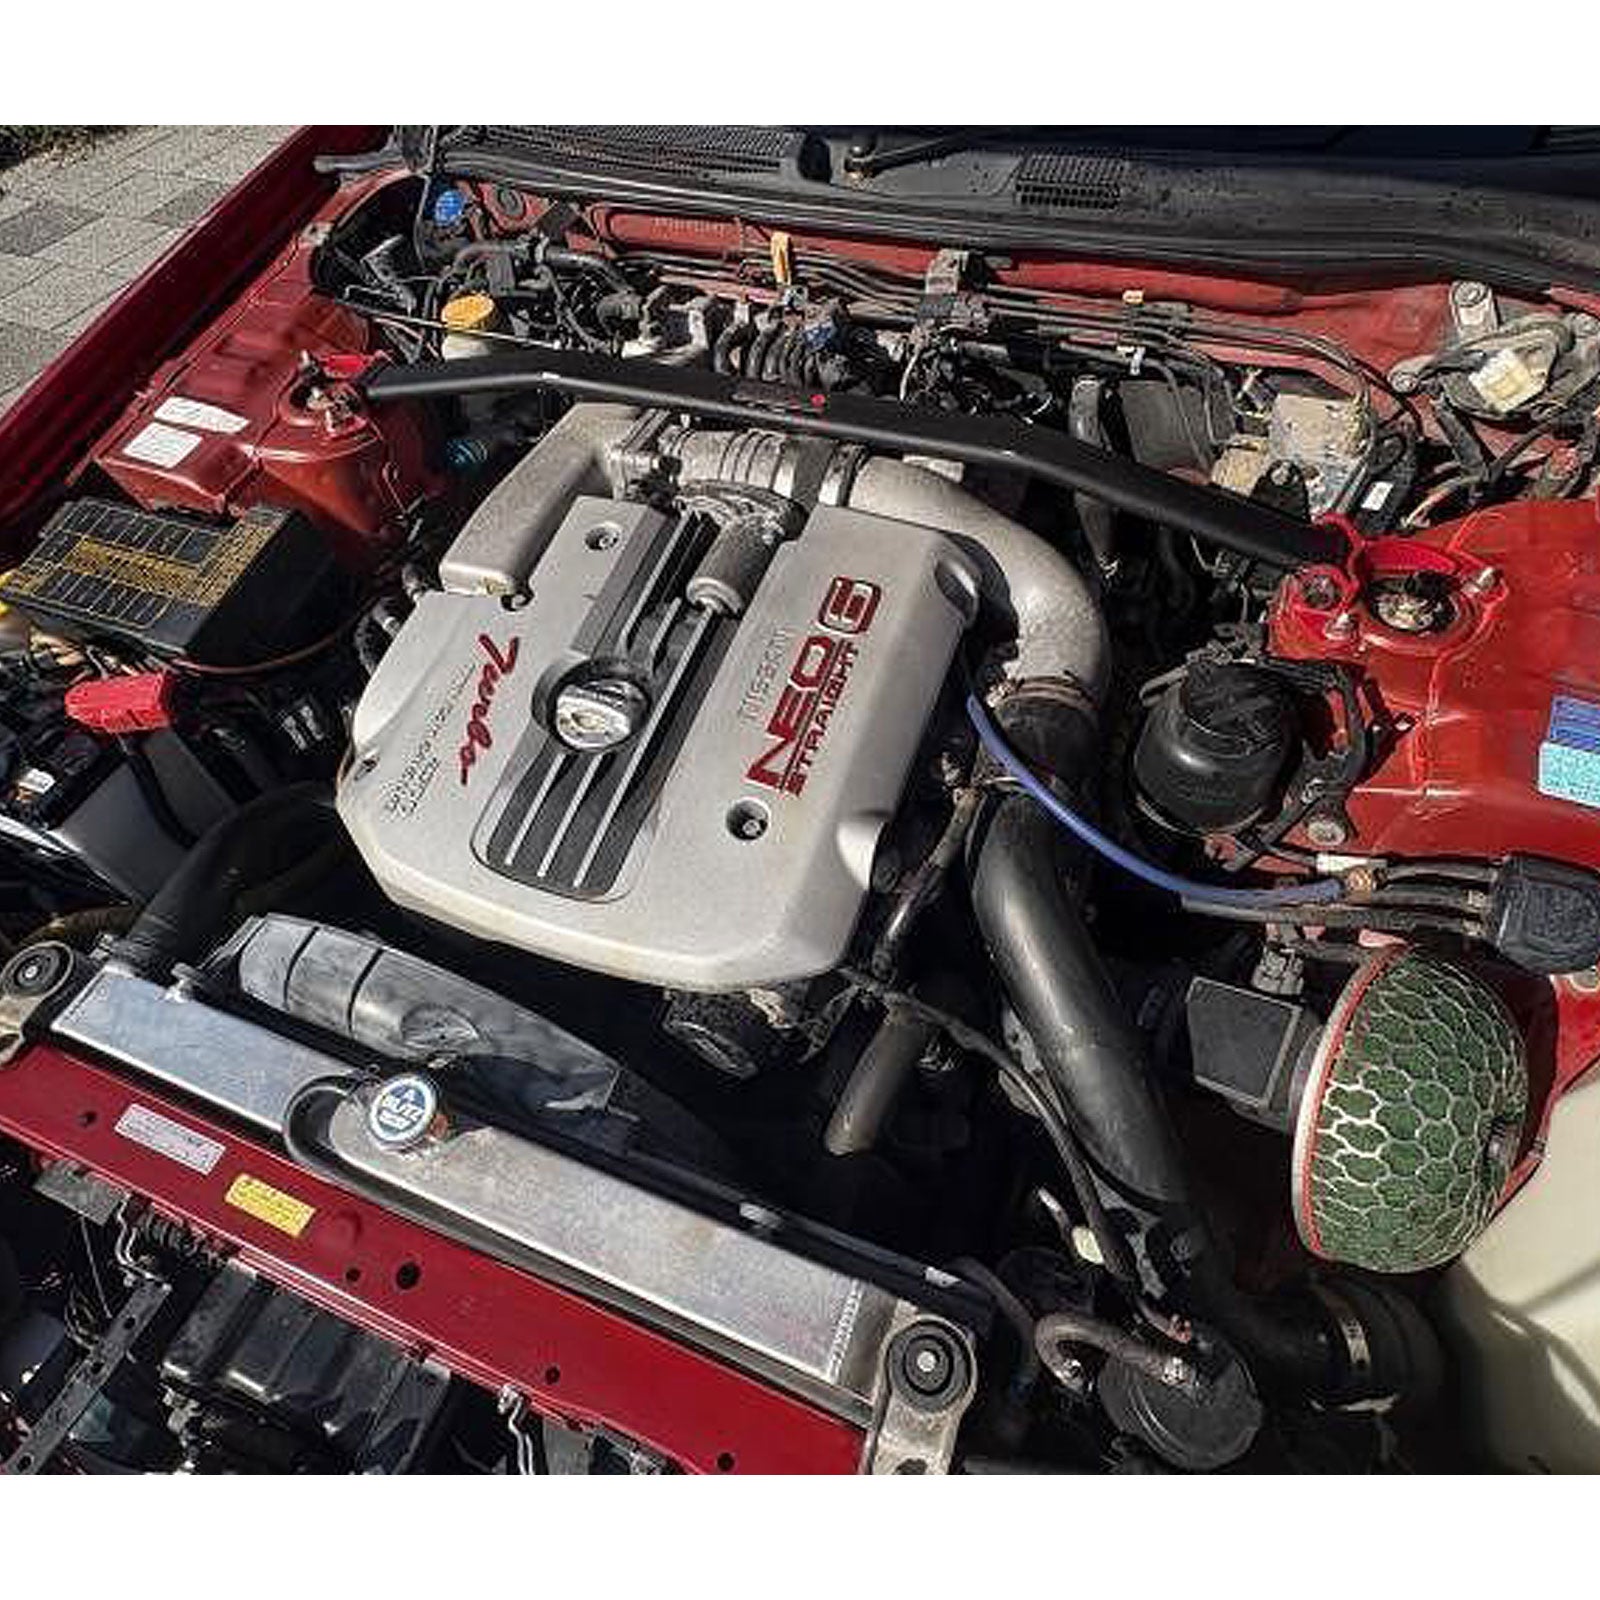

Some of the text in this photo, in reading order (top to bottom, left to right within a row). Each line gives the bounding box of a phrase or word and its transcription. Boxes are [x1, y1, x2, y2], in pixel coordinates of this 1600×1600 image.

[460, 634, 520, 786] Turbo
[746, 576, 882, 789] NEO 6
[785, 640, 859, 798] STRAIGHT
